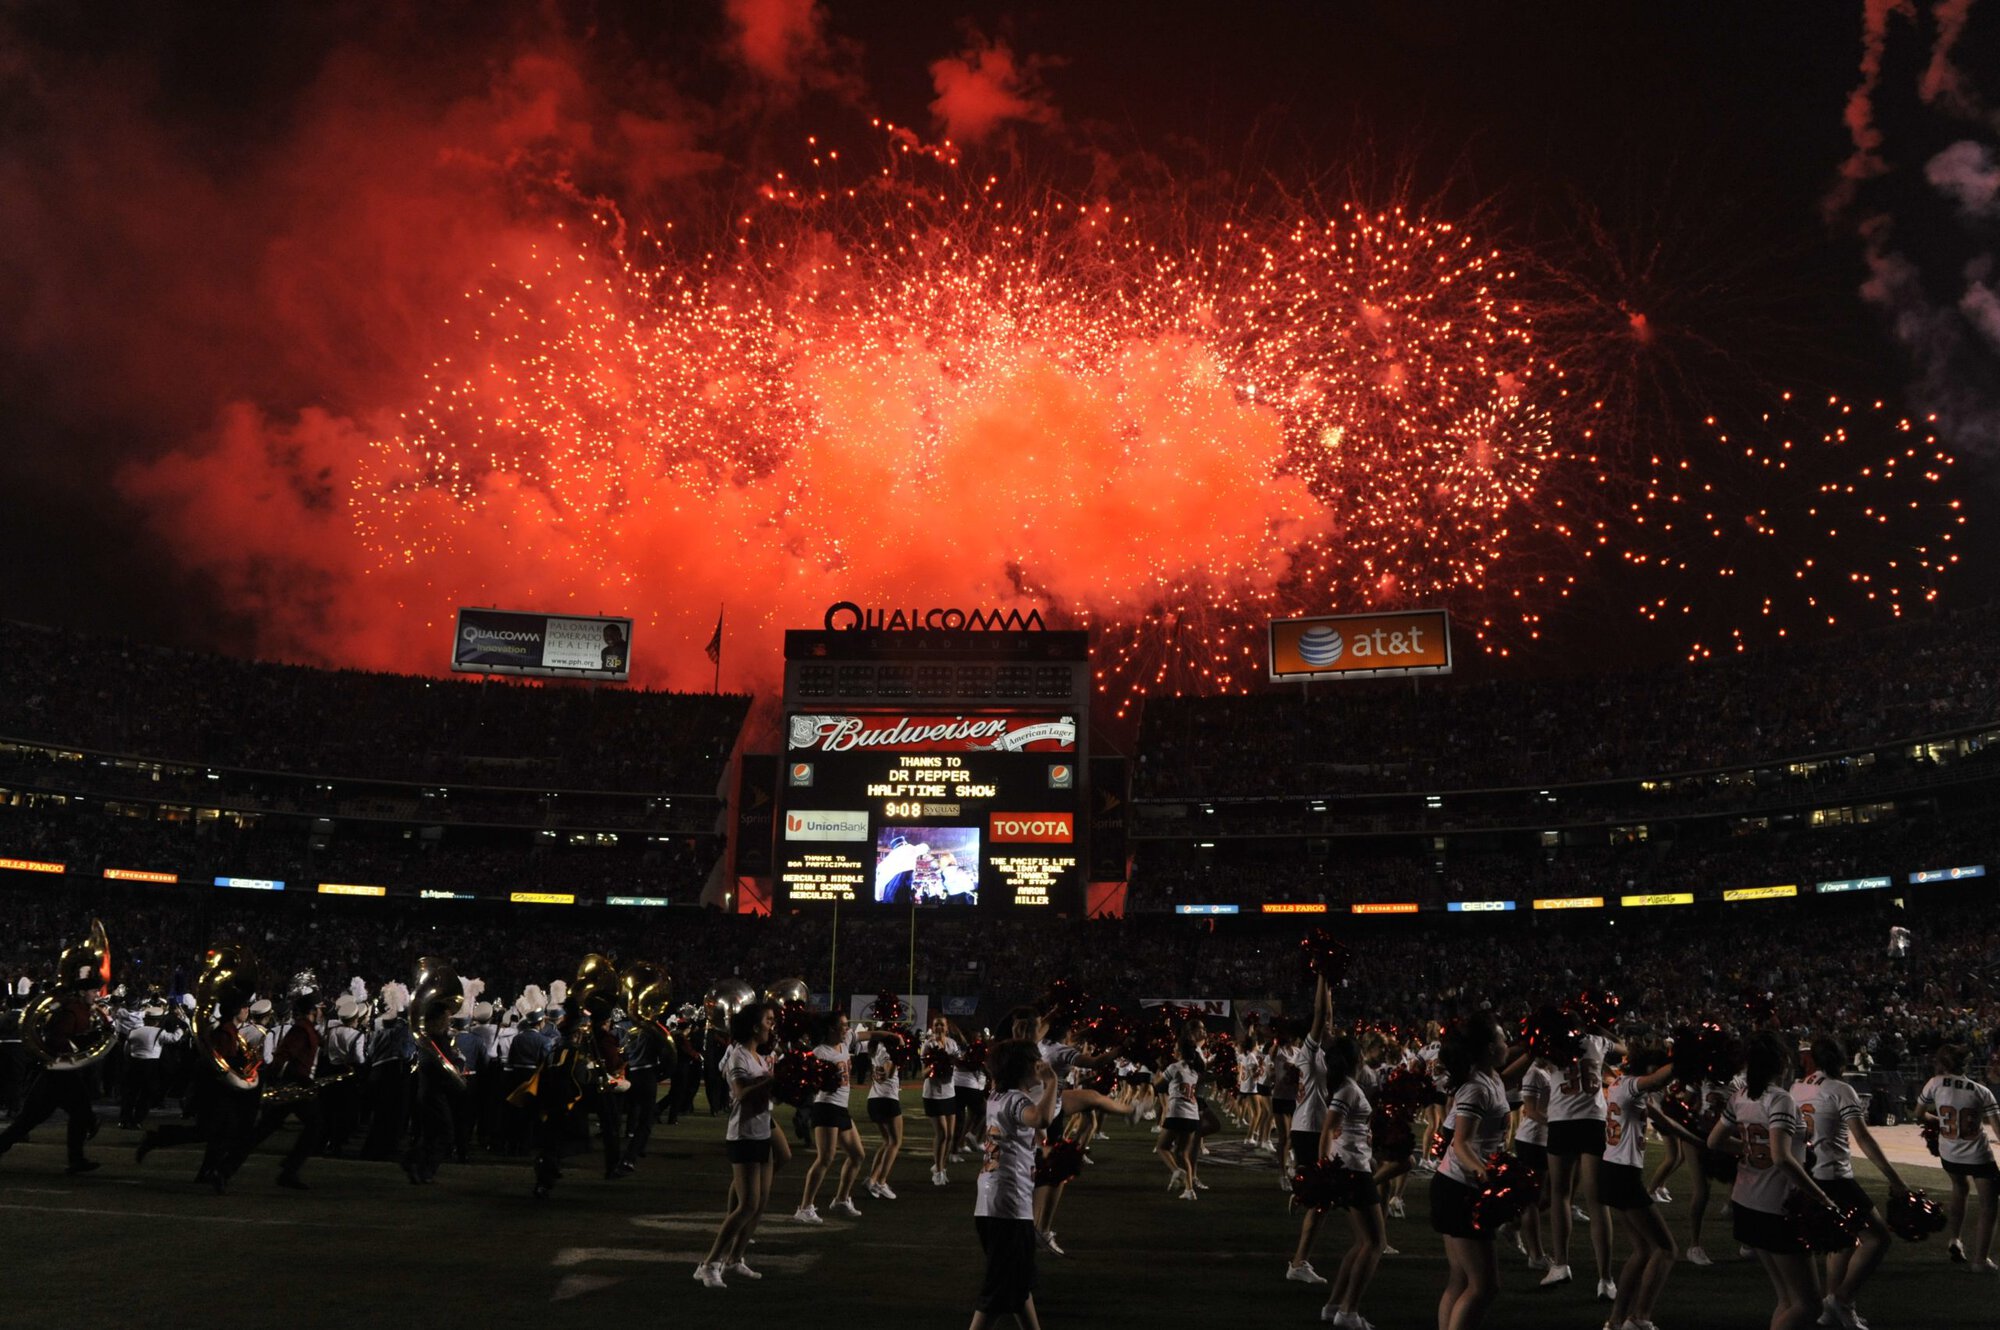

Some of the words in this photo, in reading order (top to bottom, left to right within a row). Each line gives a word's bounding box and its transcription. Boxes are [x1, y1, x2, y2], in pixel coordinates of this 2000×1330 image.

[824, 601, 1048, 632] QUALCOMM
[463, 626, 540, 643] QUALCOMM
[548, 640, 602, 650] HEALTH
[870, 639, 1028, 649] STADIUM
[1351, 626, 1425, 657] at&t
[551, 658, 595, 667] www.pph.org
[814, 716, 1007, 751] Budweiser
[1008, 728, 1047, 747] American
[1048, 727, 1074, 737] Lager
[899, 756, 942, 767] THANKS
[946, 757, 961, 767] TO
[888, 769, 910, 782] DR
[915, 770, 971, 782] PEPPER
[867, 784, 947, 797] HALFTIME
[955, 785, 996, 797] SHOW
[885, 802, 921, 818] 9:08
[740, 814, 769, 826] Sprin
[807, 821, 867, 832] UnionBank
[993, 821, 1070, 835] TOYOTA
[0, 858, 27, 869] ELLS
[29, 861, 65, 873] FARGO
[805, 861, 862, 869] PARTICIPANTS
[989, 857, 1007, 865] THE
[1010, 857, 1050, 866] PACIFIC
[1052, 858, 1076, 866] LIFE
[999, 865, 1039, 873] HOLIDAY
[1042, 865, 1065, 873] BOWL
[782, 874, 827, 882] HERCULES
[830, 875, 864, 883] MIDDLE
[820, 883, 853, 891] SCHOOL
[1827, 883, 1849, 892] Degree
[1863, 880, 1887, 889] Degree
[843, 892, 855, 900] CA
[1014, 895, 1049, 905] MILLER
[1263, 904, 1294, 913] WELLS
[1295, 904, 1326, 913] FARGO
[1461, 901, 1505, 912] GEICO
[1543, 899, 1594, 909] CYMER
[1203, 1001, 1224, 1015] N
[1942, 1077, 1975, 1091] BGA
